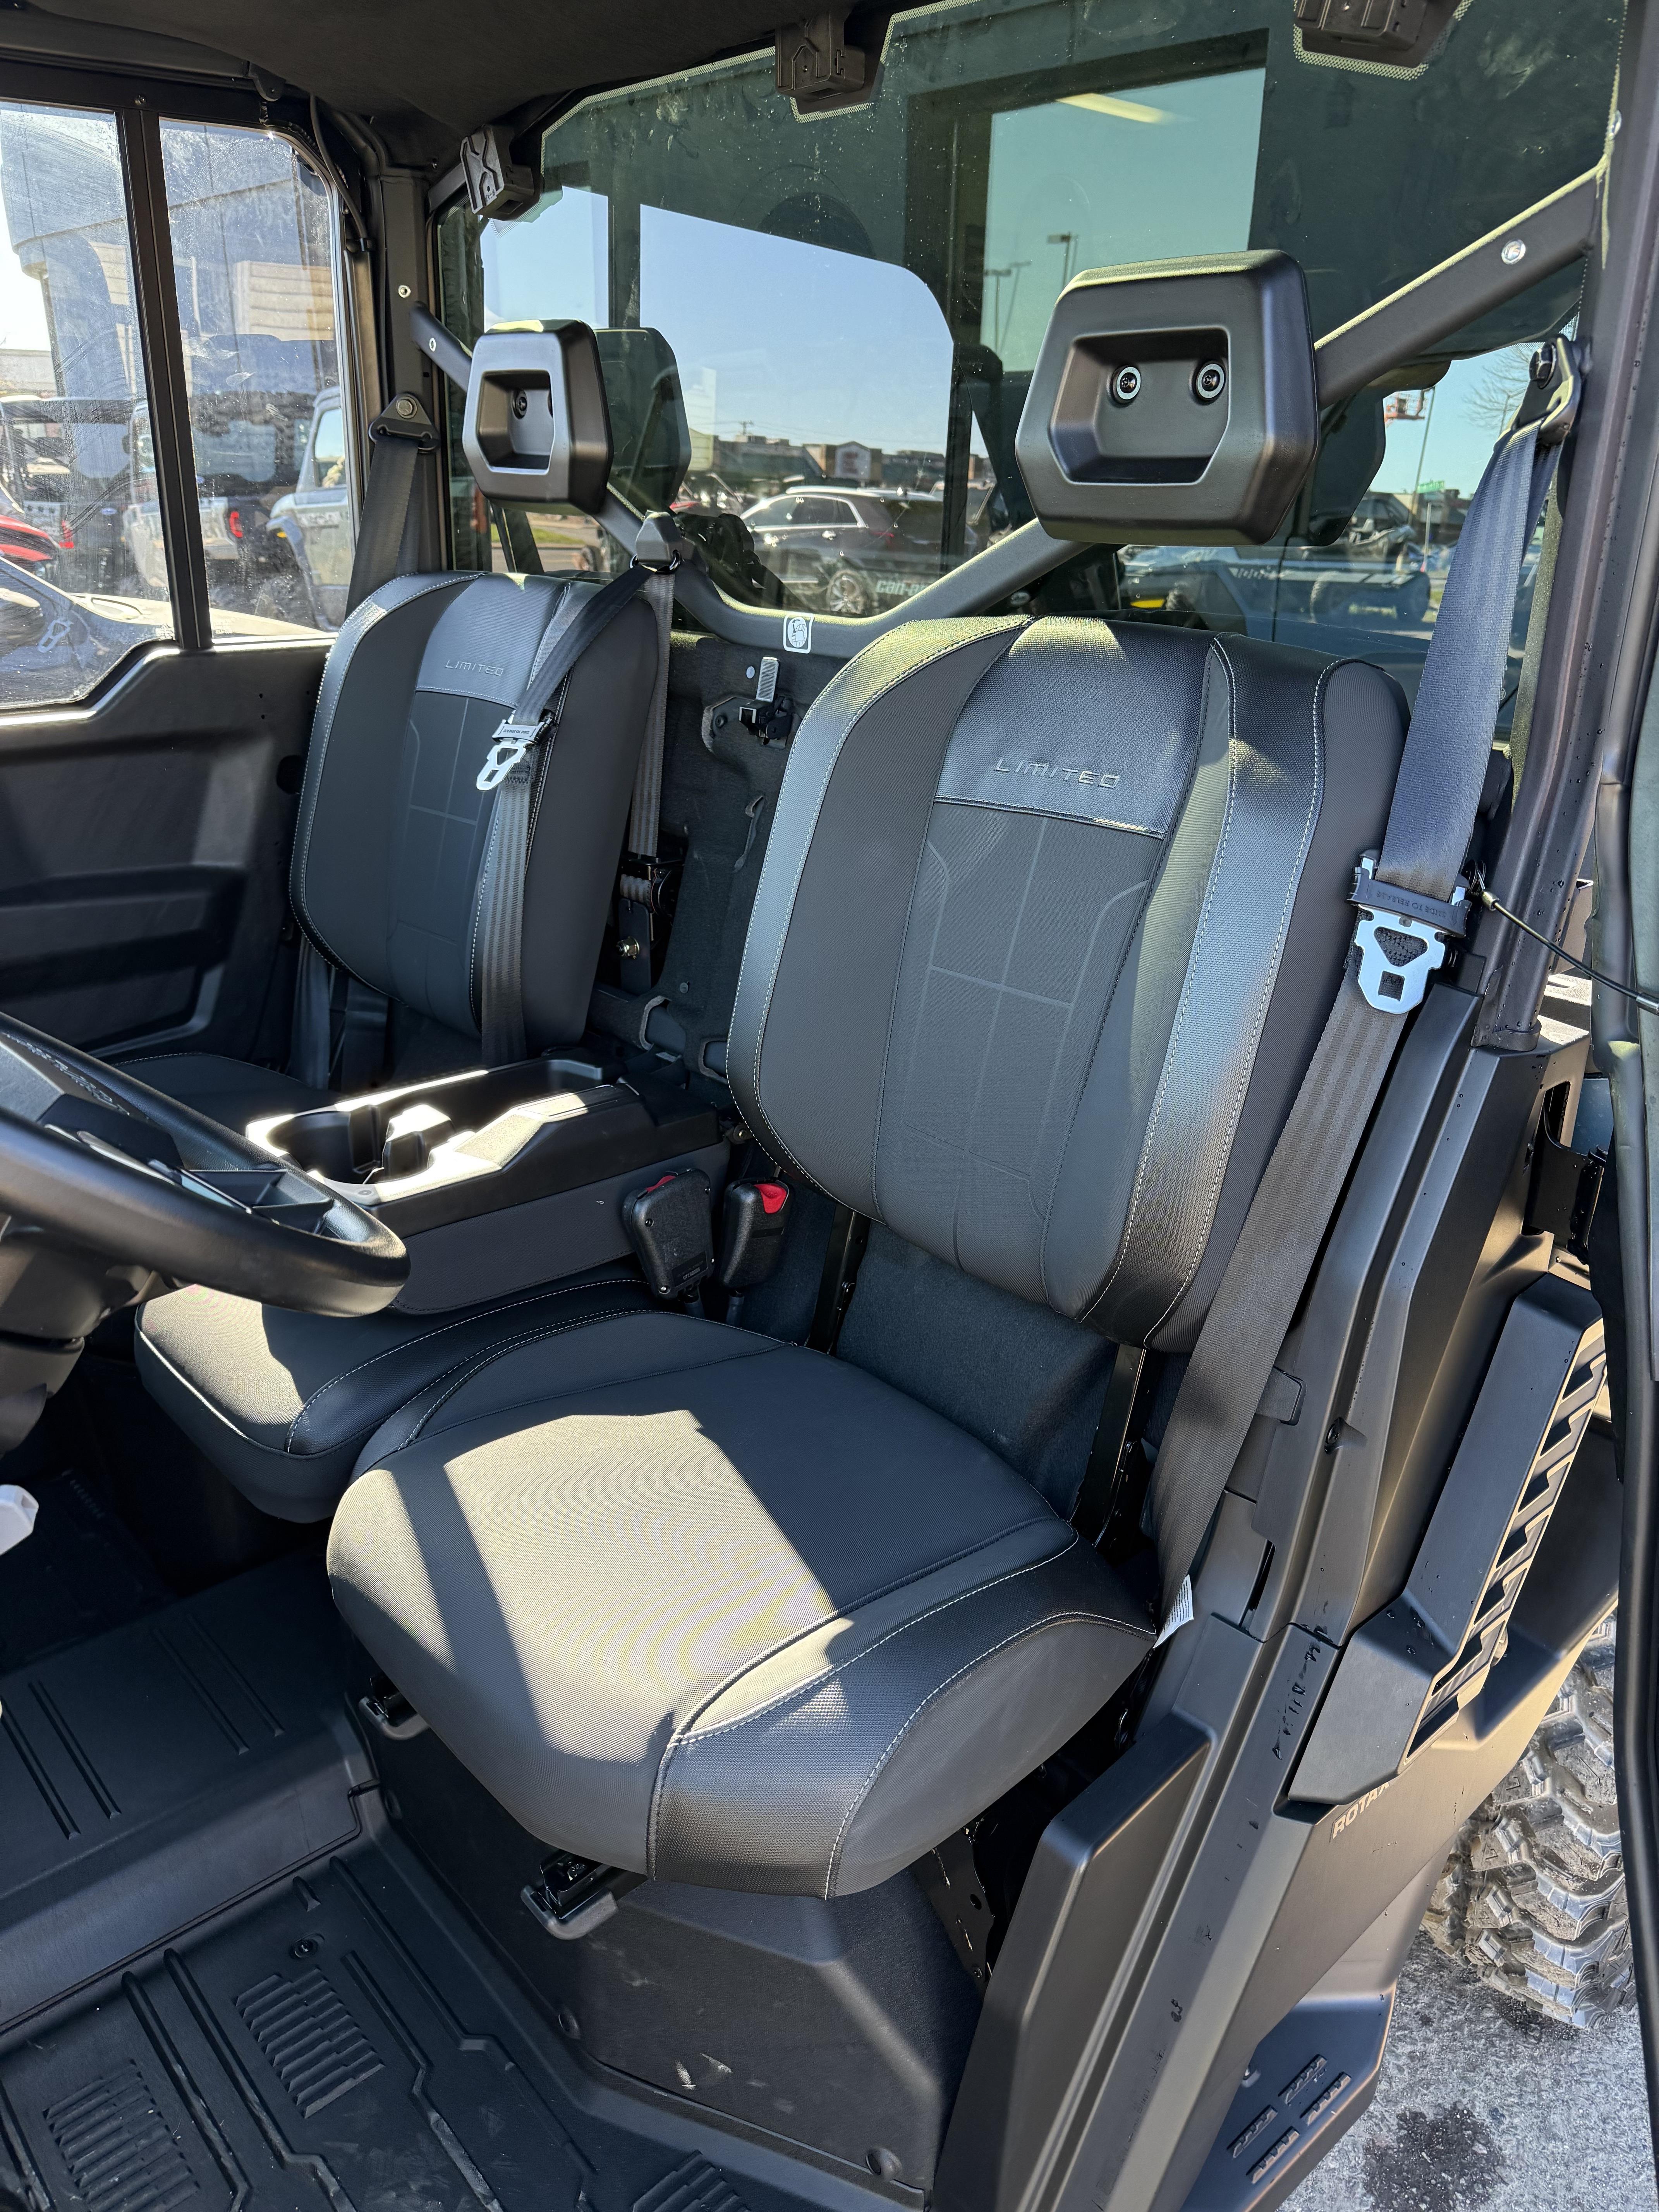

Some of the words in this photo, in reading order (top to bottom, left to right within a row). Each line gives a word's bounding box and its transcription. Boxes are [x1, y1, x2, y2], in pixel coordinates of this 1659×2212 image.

[445, 659, 504, 677] LIMITED
[994, 758, 1120, 789] LIMITED
[1412, 902, 1423, 911] TO
